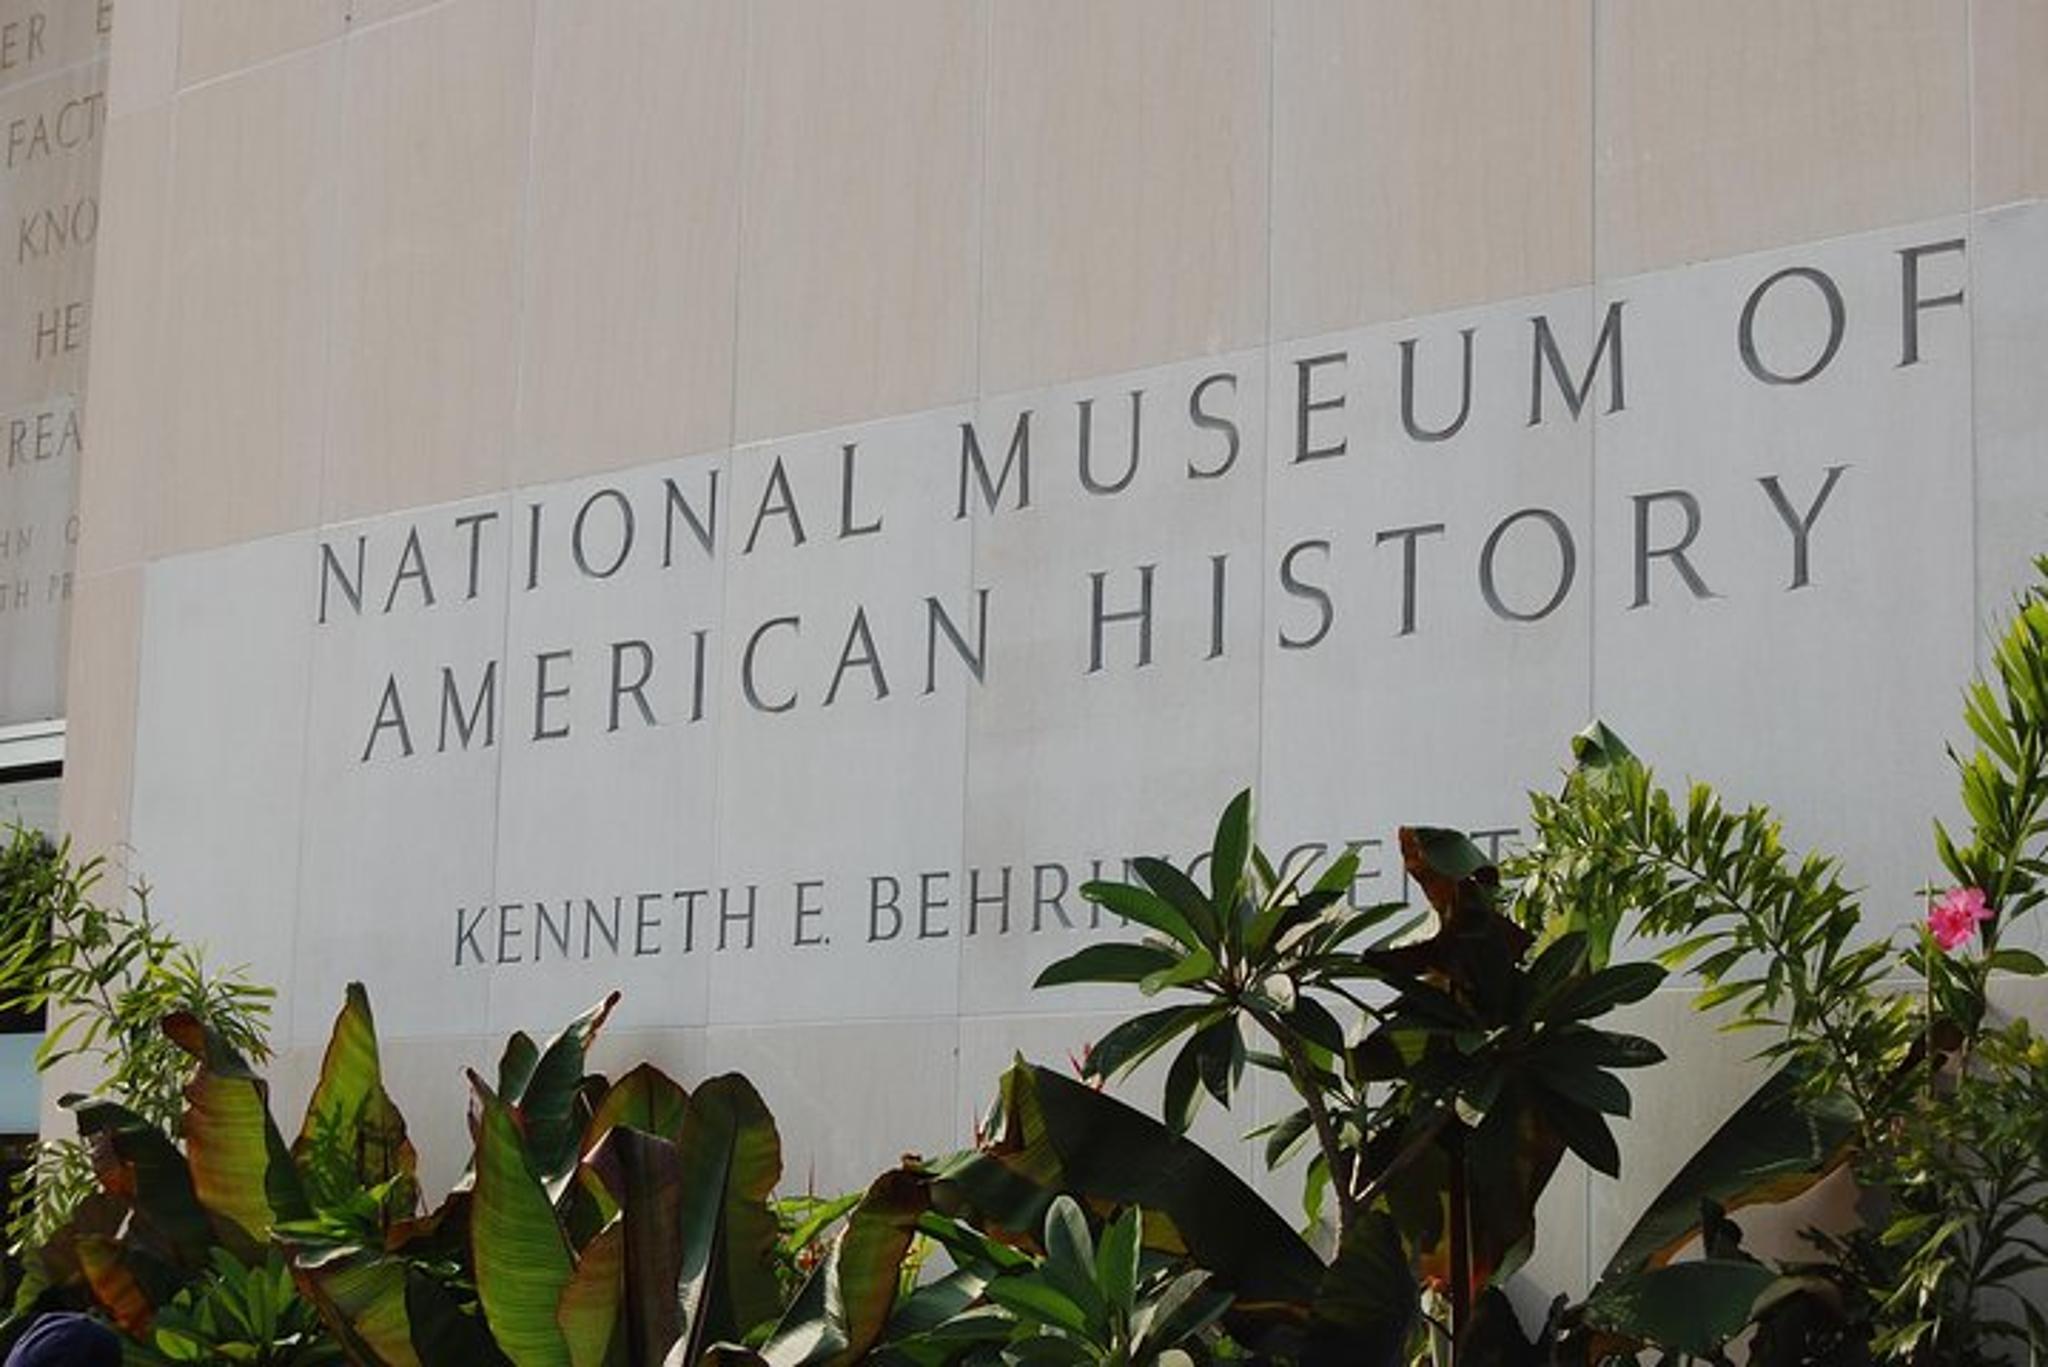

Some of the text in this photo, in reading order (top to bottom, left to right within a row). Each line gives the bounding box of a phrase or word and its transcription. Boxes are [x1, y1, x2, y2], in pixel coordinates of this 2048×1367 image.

[8, 91, 107, 168] FACT
[18, 198, 99, 265] KNO
[318, 238, 1967, 624] NATIONAL MUSEUM OF
[361, 464, 1854, 762] AMERICAN HISTORY
[454, 884, 758, 967] KENNETH
[793, 880, 831, 946] E.
